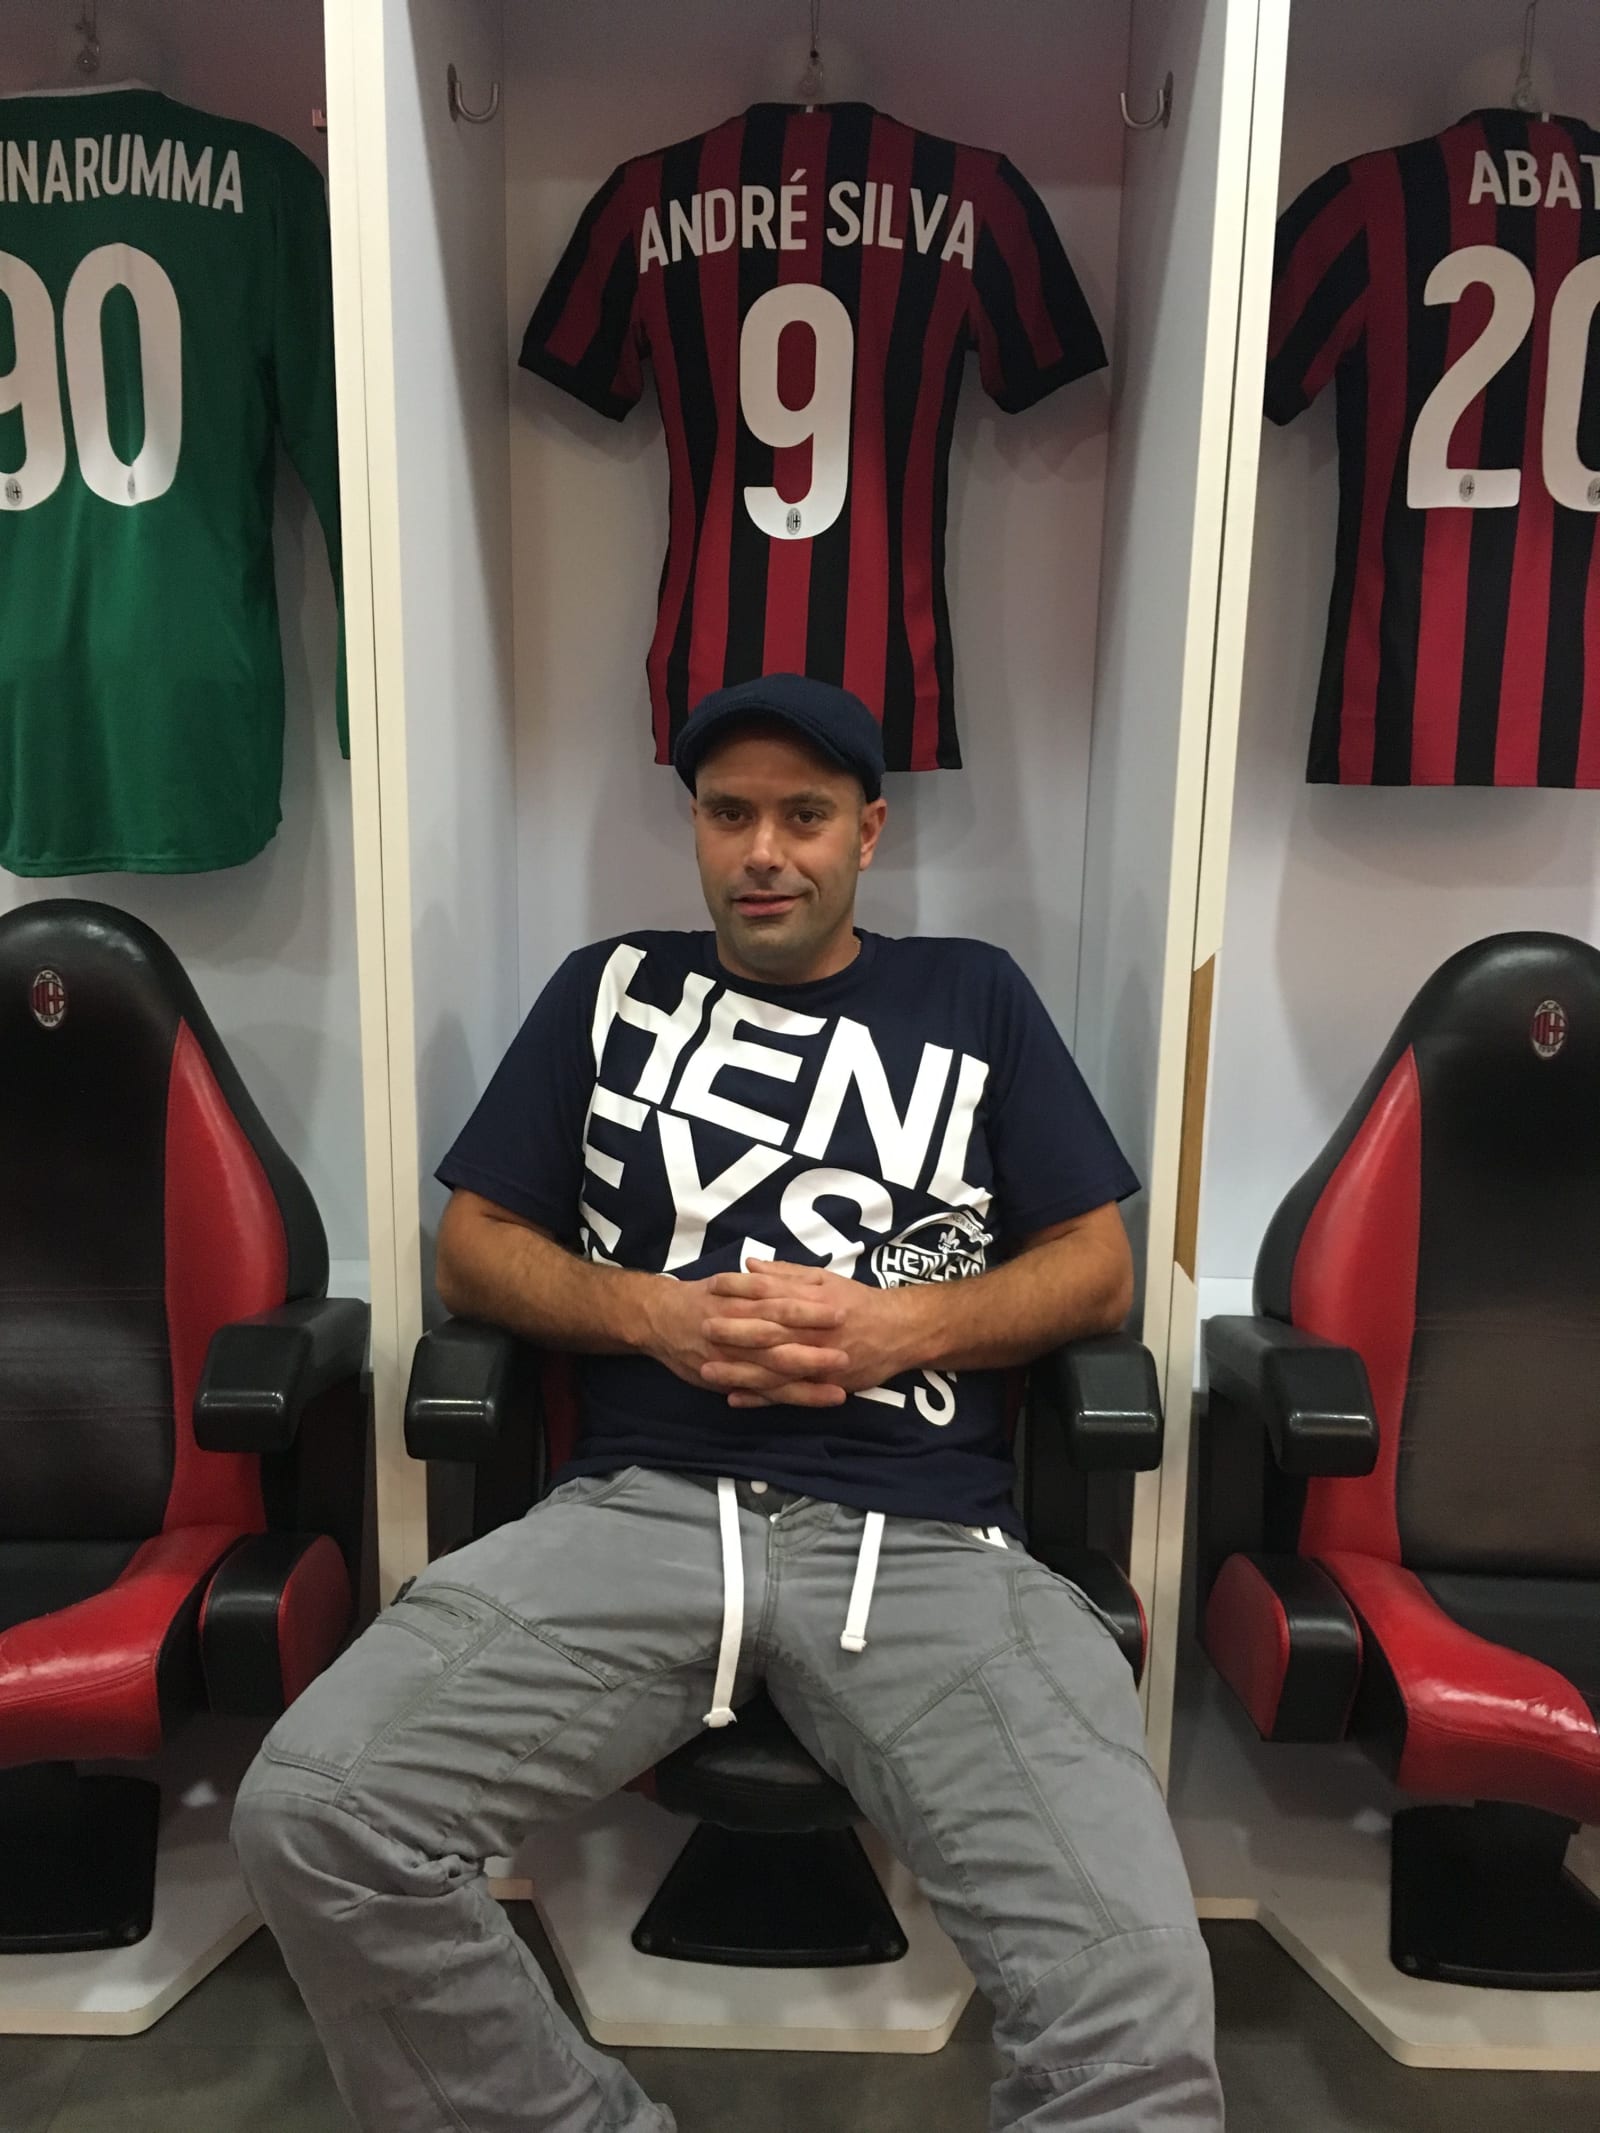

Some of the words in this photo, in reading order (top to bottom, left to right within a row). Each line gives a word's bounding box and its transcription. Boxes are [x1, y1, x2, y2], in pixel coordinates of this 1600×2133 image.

[639, 168, 808, 274] ANDRÉ
[826, 180, 975, 270] SILVA
[0, 242, 183, 511] 90
[739, 283, 854, 540] 9
